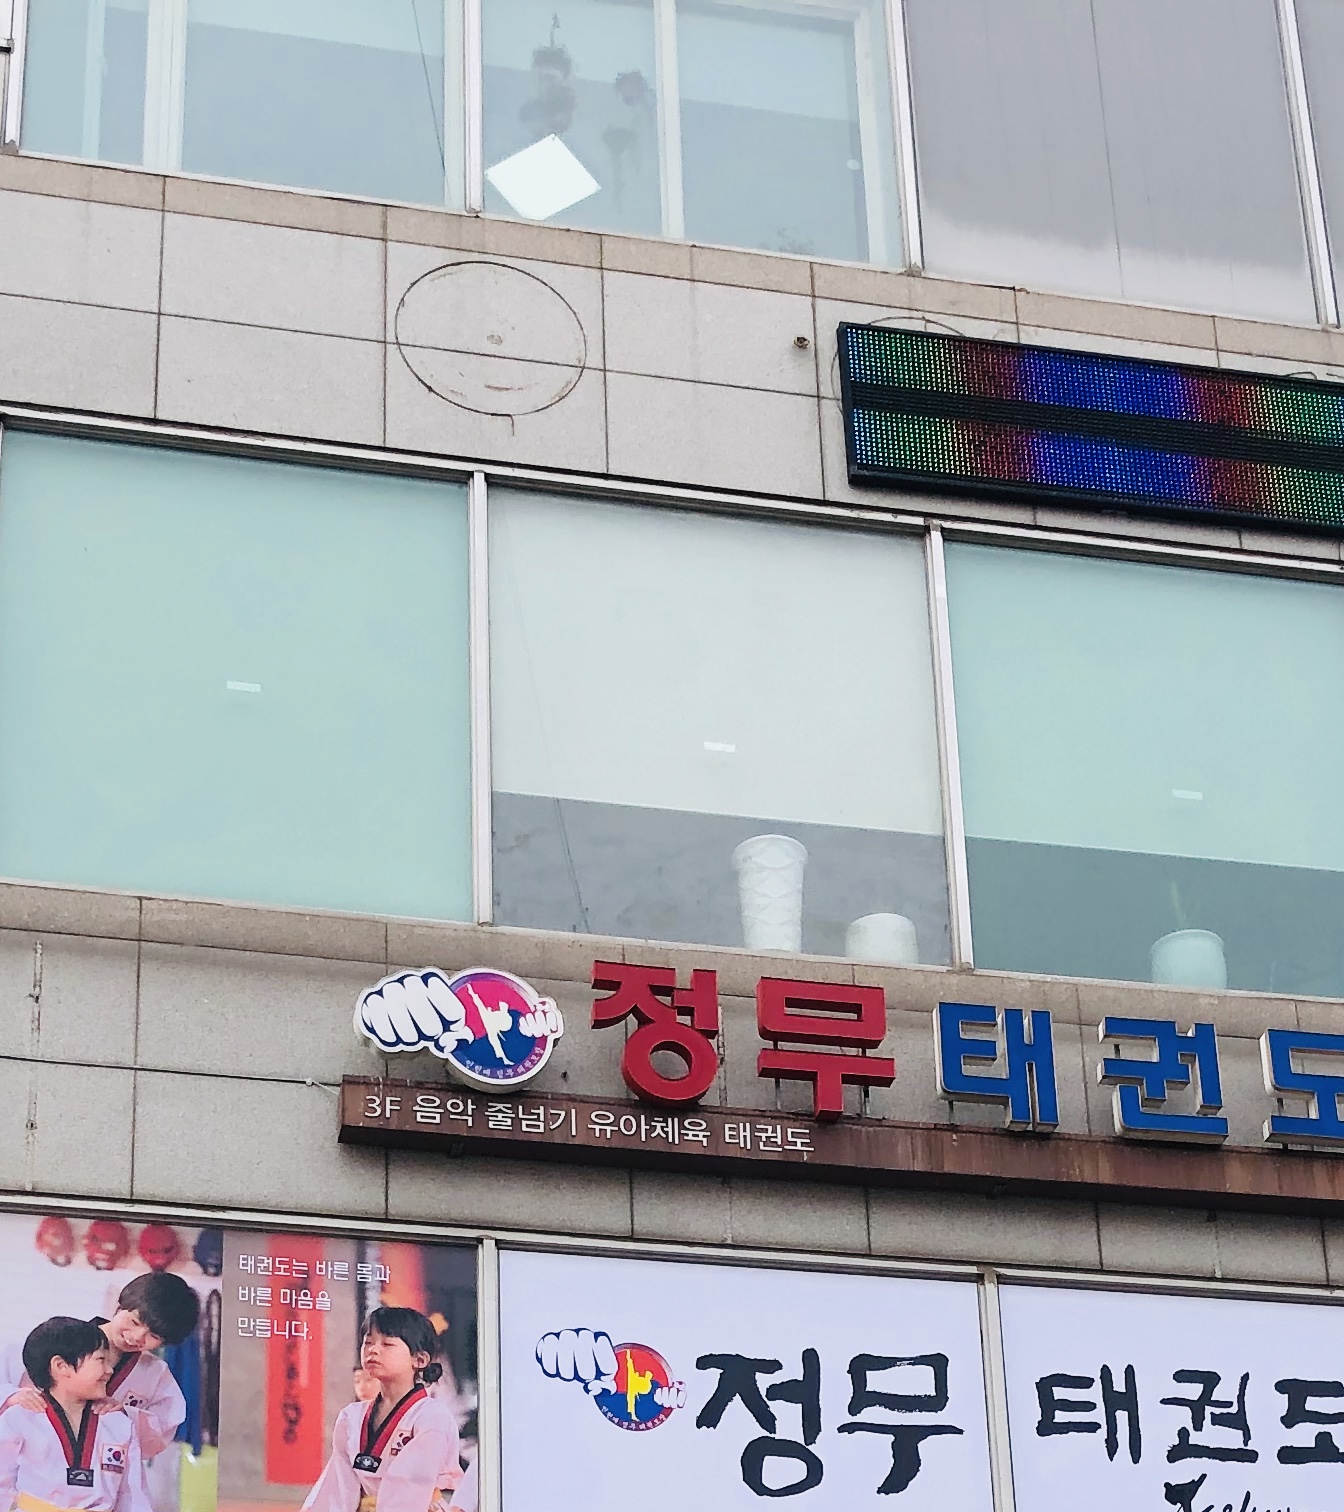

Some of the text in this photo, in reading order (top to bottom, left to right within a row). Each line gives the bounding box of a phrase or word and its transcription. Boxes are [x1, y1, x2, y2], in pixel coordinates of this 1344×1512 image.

[591, 960, 895, 1122] 정무
[364, 1095, 815, 1153] 3F 음악 줄넘기 유아체육 태권도
[238, 1254, 392, 1284] 태권도는 바른 몸과
[238, 1286, 332, 1311] 바른 마음을
[237, 1317, 313, 1341] 만듭니다.
[695, 1348, 964, 1498] 정무
